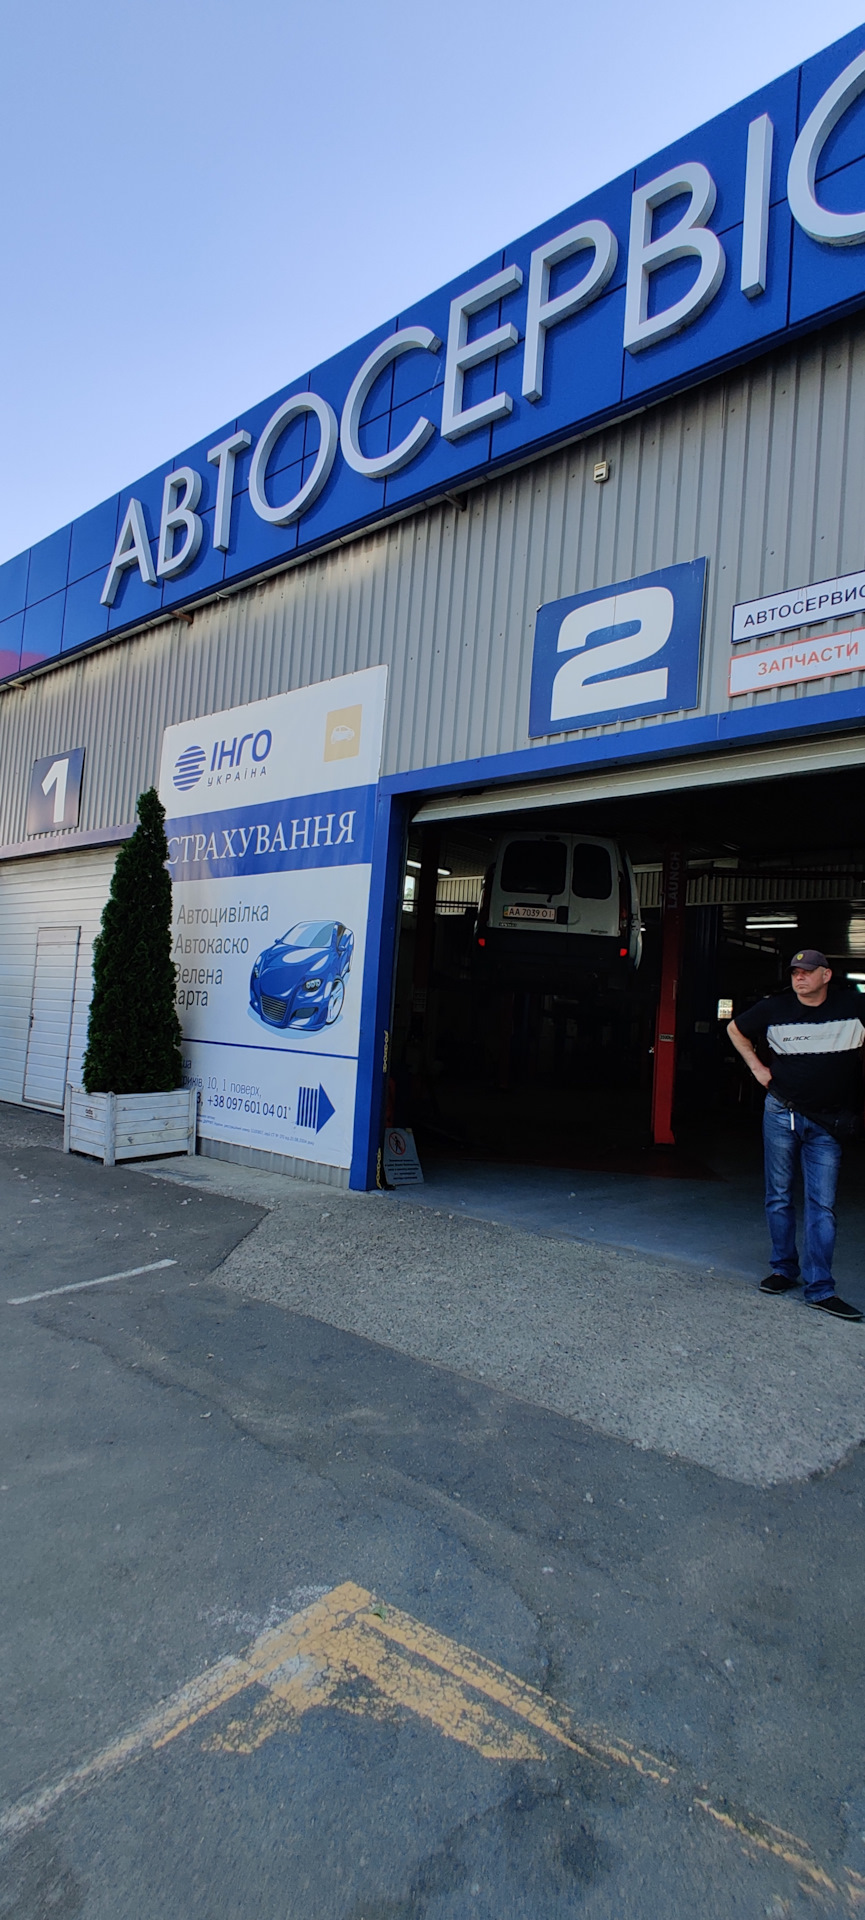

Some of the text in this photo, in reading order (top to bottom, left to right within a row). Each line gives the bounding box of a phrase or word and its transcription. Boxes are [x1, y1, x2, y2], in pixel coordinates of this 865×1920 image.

[551, 586, 674, 722] 2
[757, 642, 859, 676] ЗАПЧАСТИ
[210, 729, 273, 772] ІНГО
[41, 758, 69, 823] 1
[207, 765, 267, 787] УКРАЇНА
[166, 810, 357, 865] СТРАХУВАННЯ
[667, 851, 681, 909] LAUNCH
[177, 901, 270, 928] Автоцивілка
[522, 908, 540, 918] 7039
[174, 933, 250, 954] Автокаско
[174, 989, 209, 1011] арта
